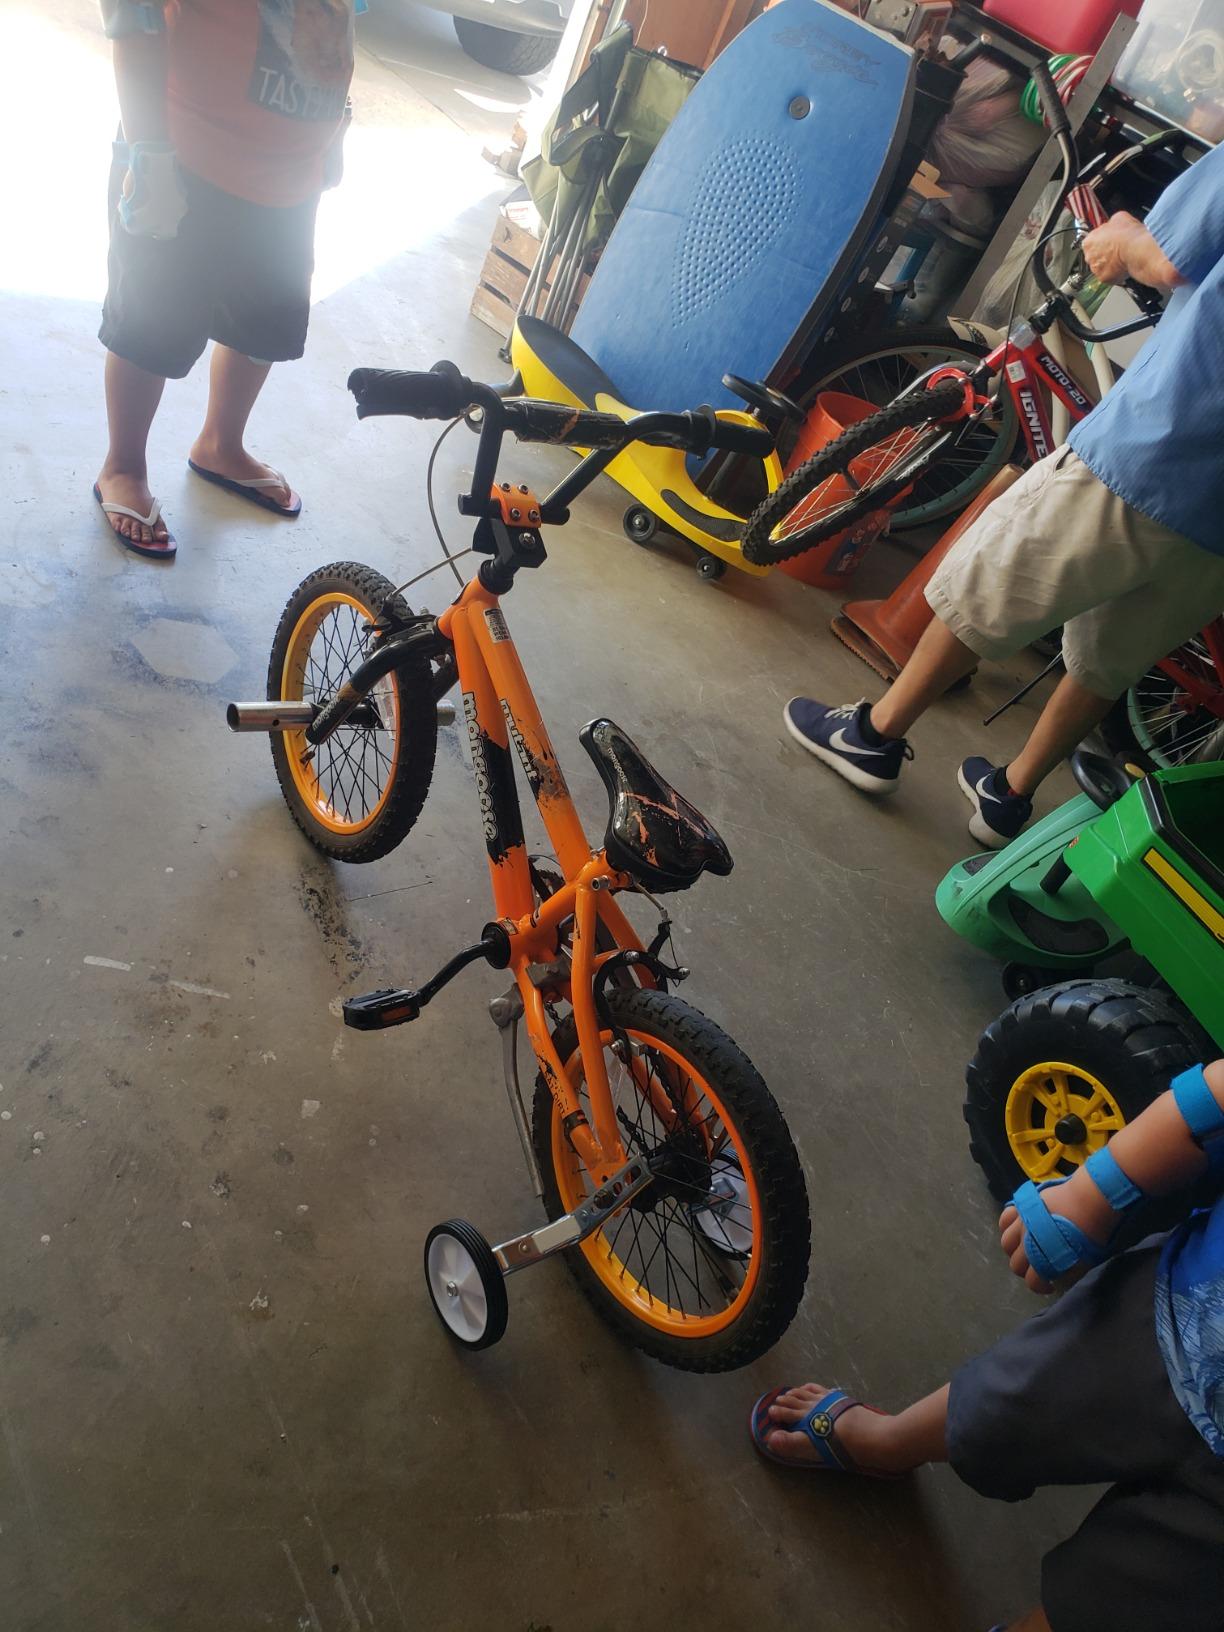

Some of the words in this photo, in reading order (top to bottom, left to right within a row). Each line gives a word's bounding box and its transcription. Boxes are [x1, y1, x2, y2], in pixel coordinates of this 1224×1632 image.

[1040, 355, 1086, 405] MOTO-20
[1020, 391, 1049, 458] IGNITE
[462, 691, 497, 841] mongoose
[607, 747, 627, 783] mongoose
